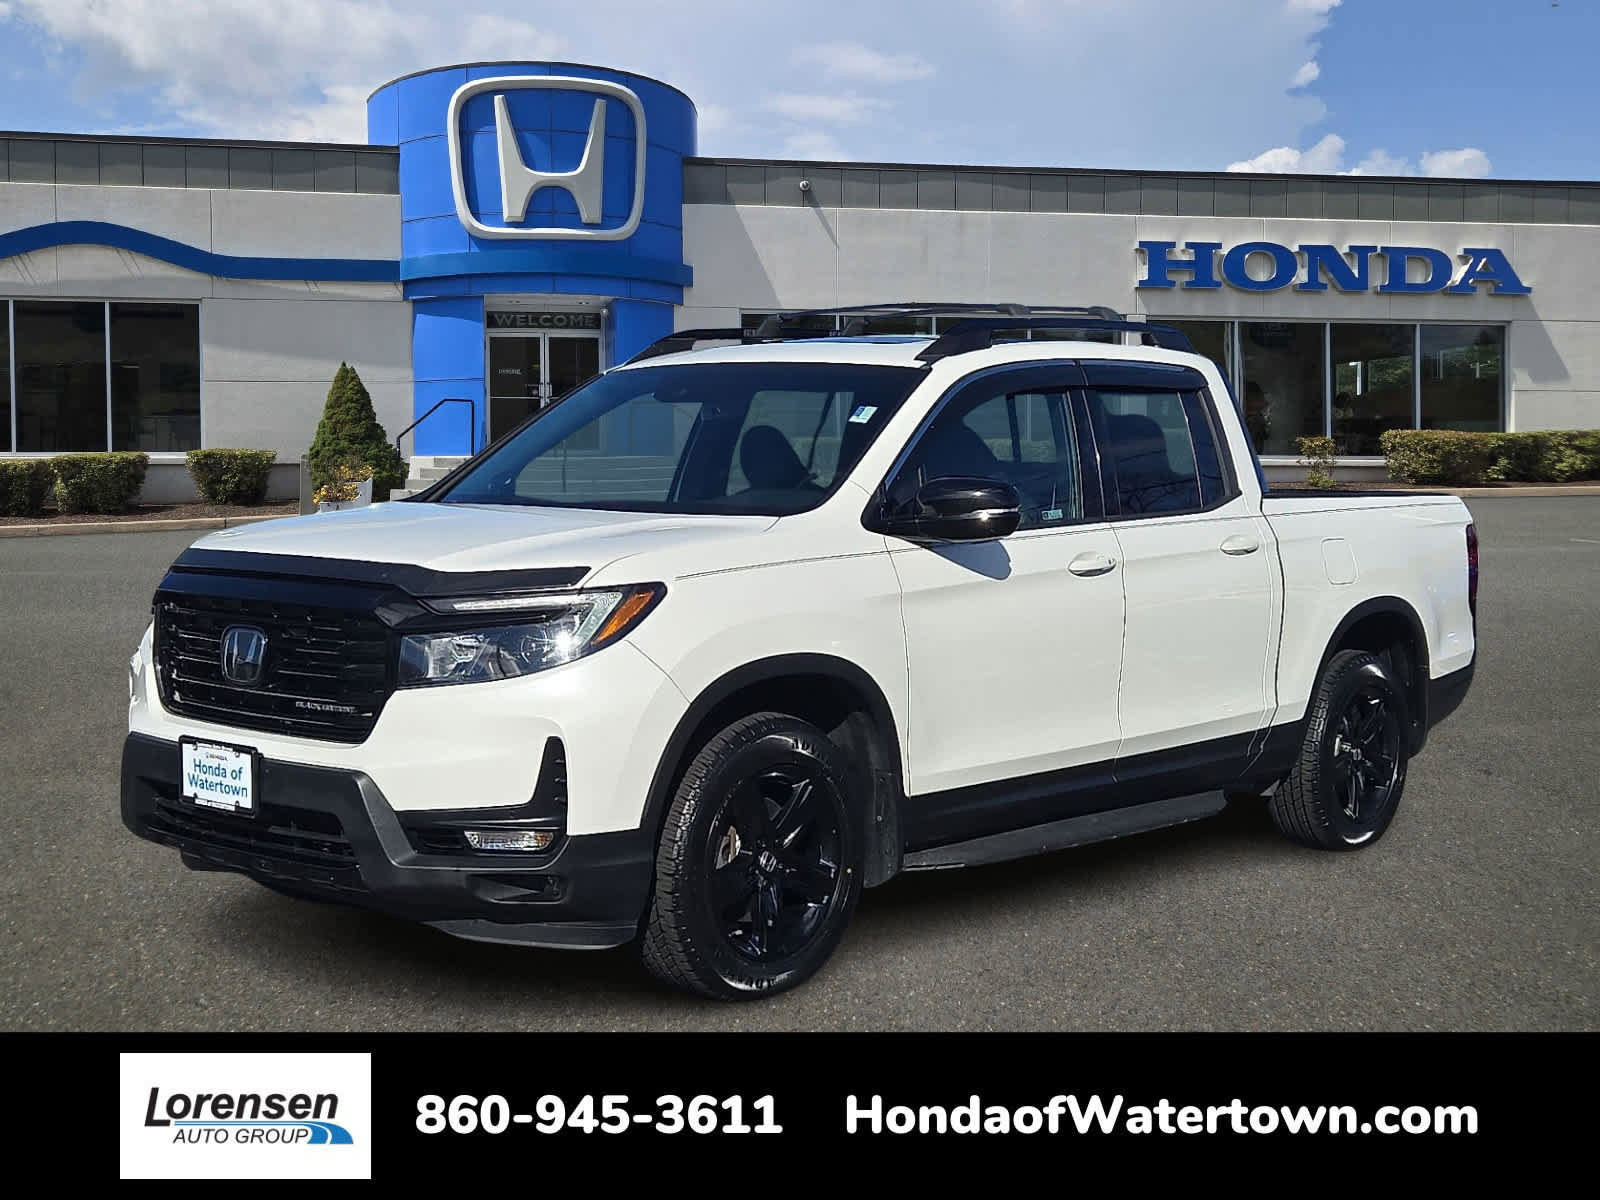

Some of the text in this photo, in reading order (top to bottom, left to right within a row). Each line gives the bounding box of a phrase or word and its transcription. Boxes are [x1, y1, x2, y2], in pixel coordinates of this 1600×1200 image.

[1137, 241, 1531, 295] HONDA
[494, 313, 597, 328] WELCOME
[193, 758, 244, 781] Honda of
[187, 772, 248, 798] Watertown
